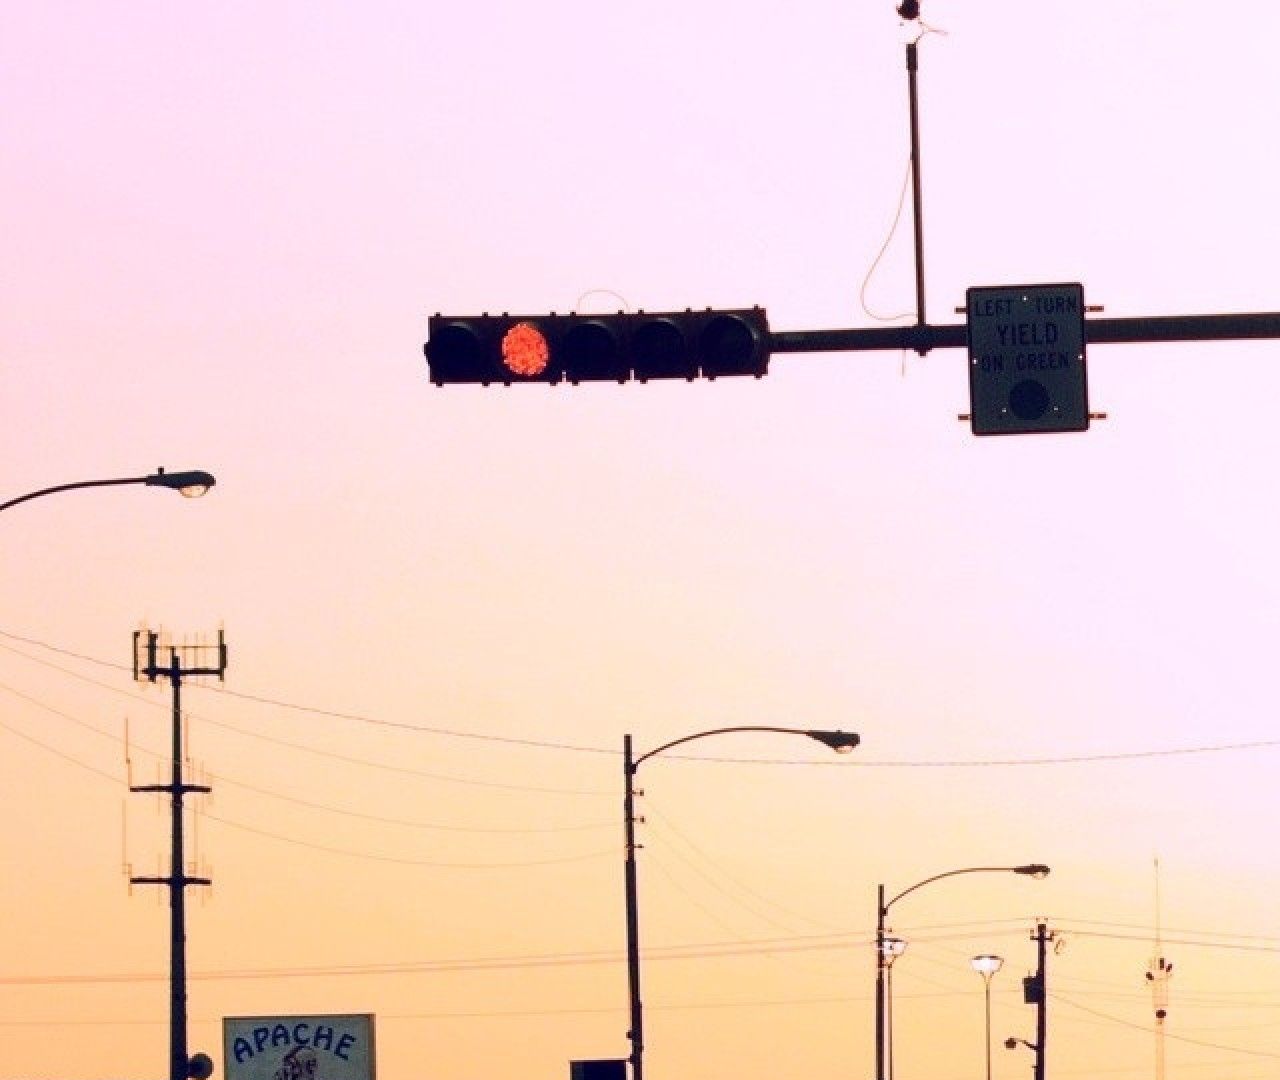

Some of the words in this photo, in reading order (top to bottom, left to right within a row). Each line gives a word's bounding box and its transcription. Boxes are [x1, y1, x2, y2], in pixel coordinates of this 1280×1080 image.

[974, 300, 1013, 316] LEFT
[1037, 296, 1077, 314] TURN
[997, 322, 1058, 345] YIELD
[981, 356, 1002, 372] ON
[1016, 351, 1070, 371] GREEN
[233, 1023, 356, 1062] APACHE
